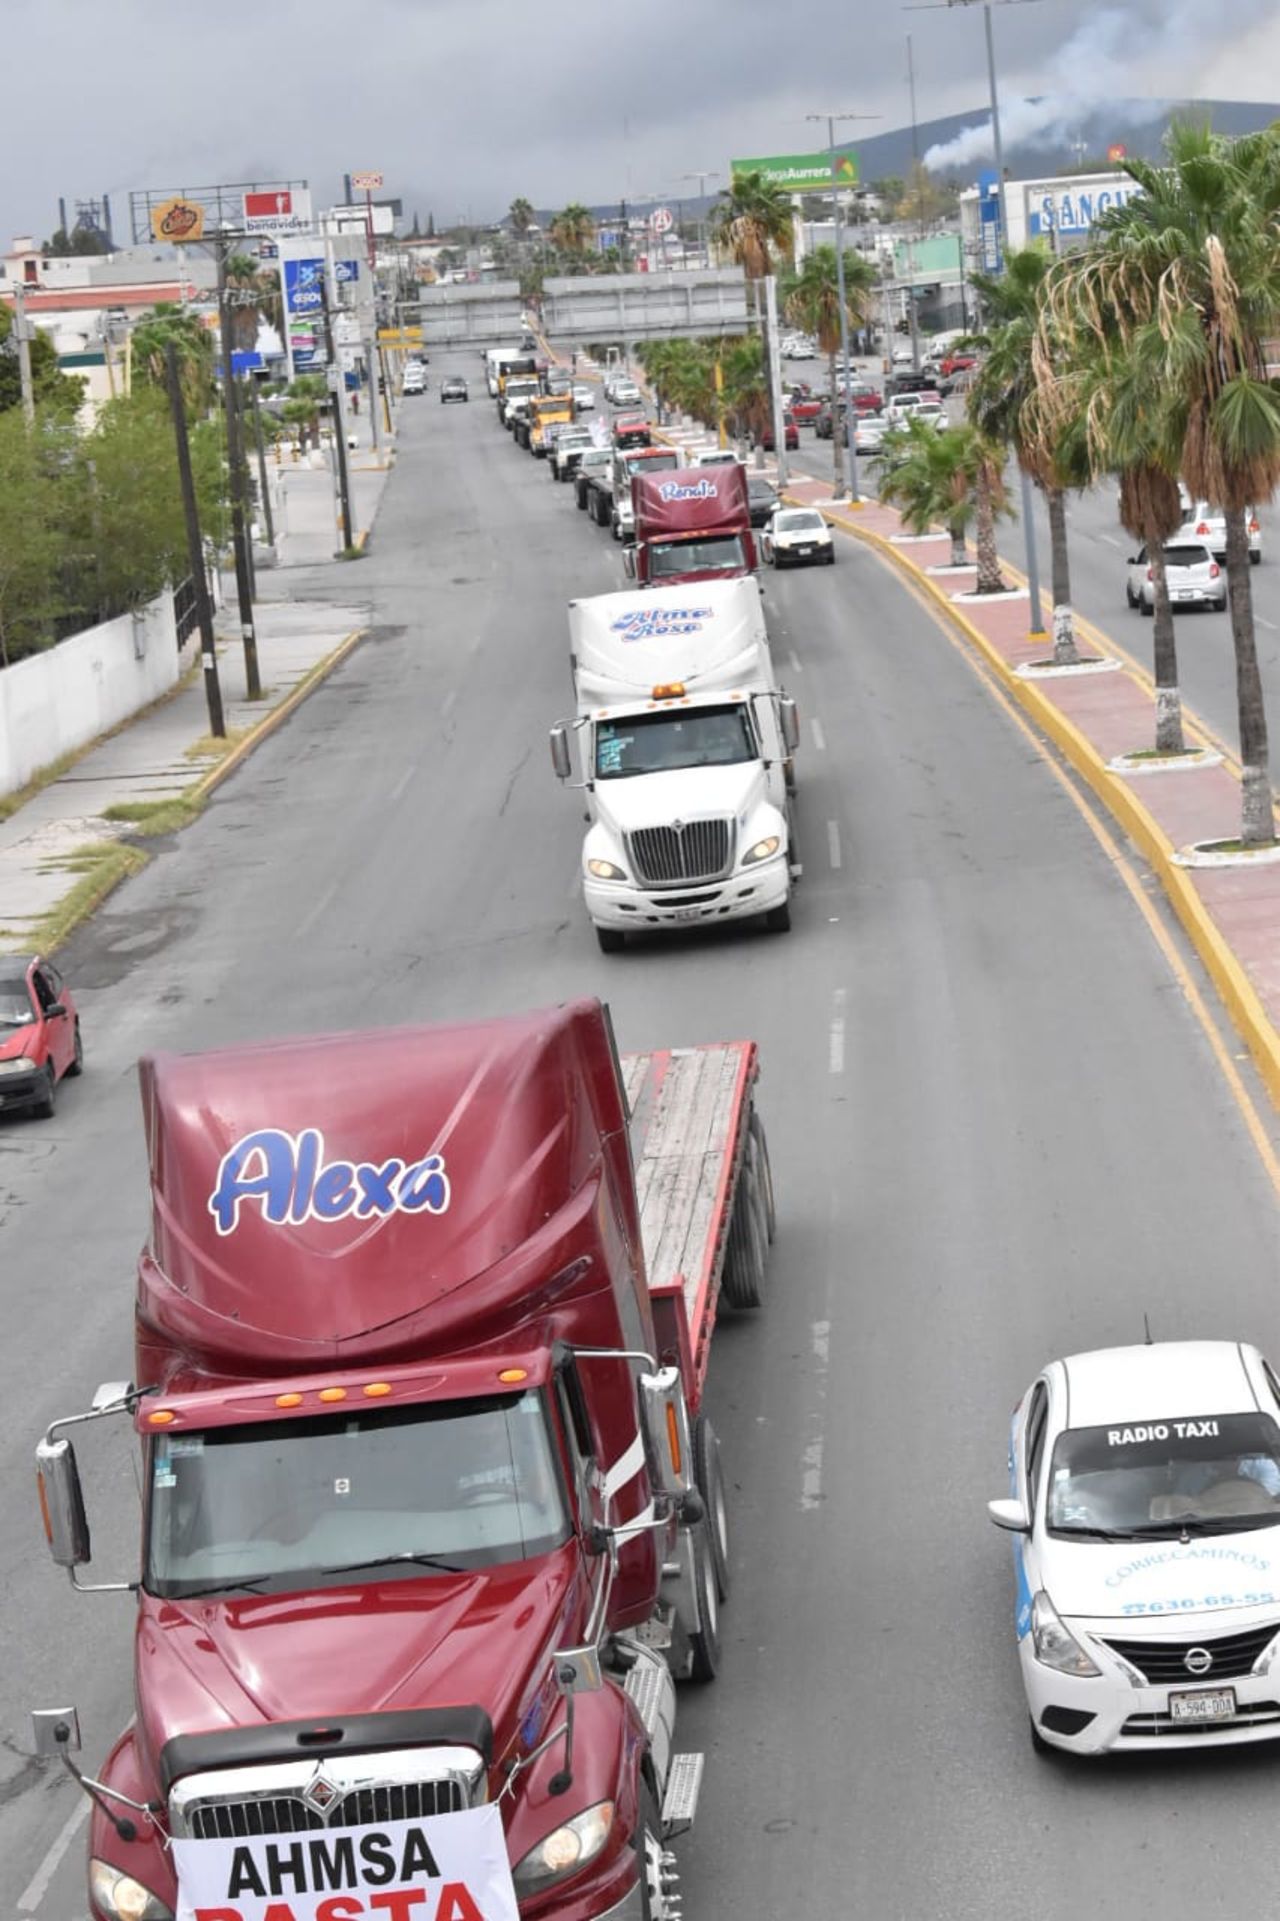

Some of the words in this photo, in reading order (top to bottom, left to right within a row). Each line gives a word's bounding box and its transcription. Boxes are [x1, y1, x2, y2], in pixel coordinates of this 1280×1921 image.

[247, 216, 309, 231] benavides
[1107, 1424, 1169, 1446] RADIO
[1173, 1420, 1219, 1438] TAXI
[227, 1827, 441, 1899] AHMSA
